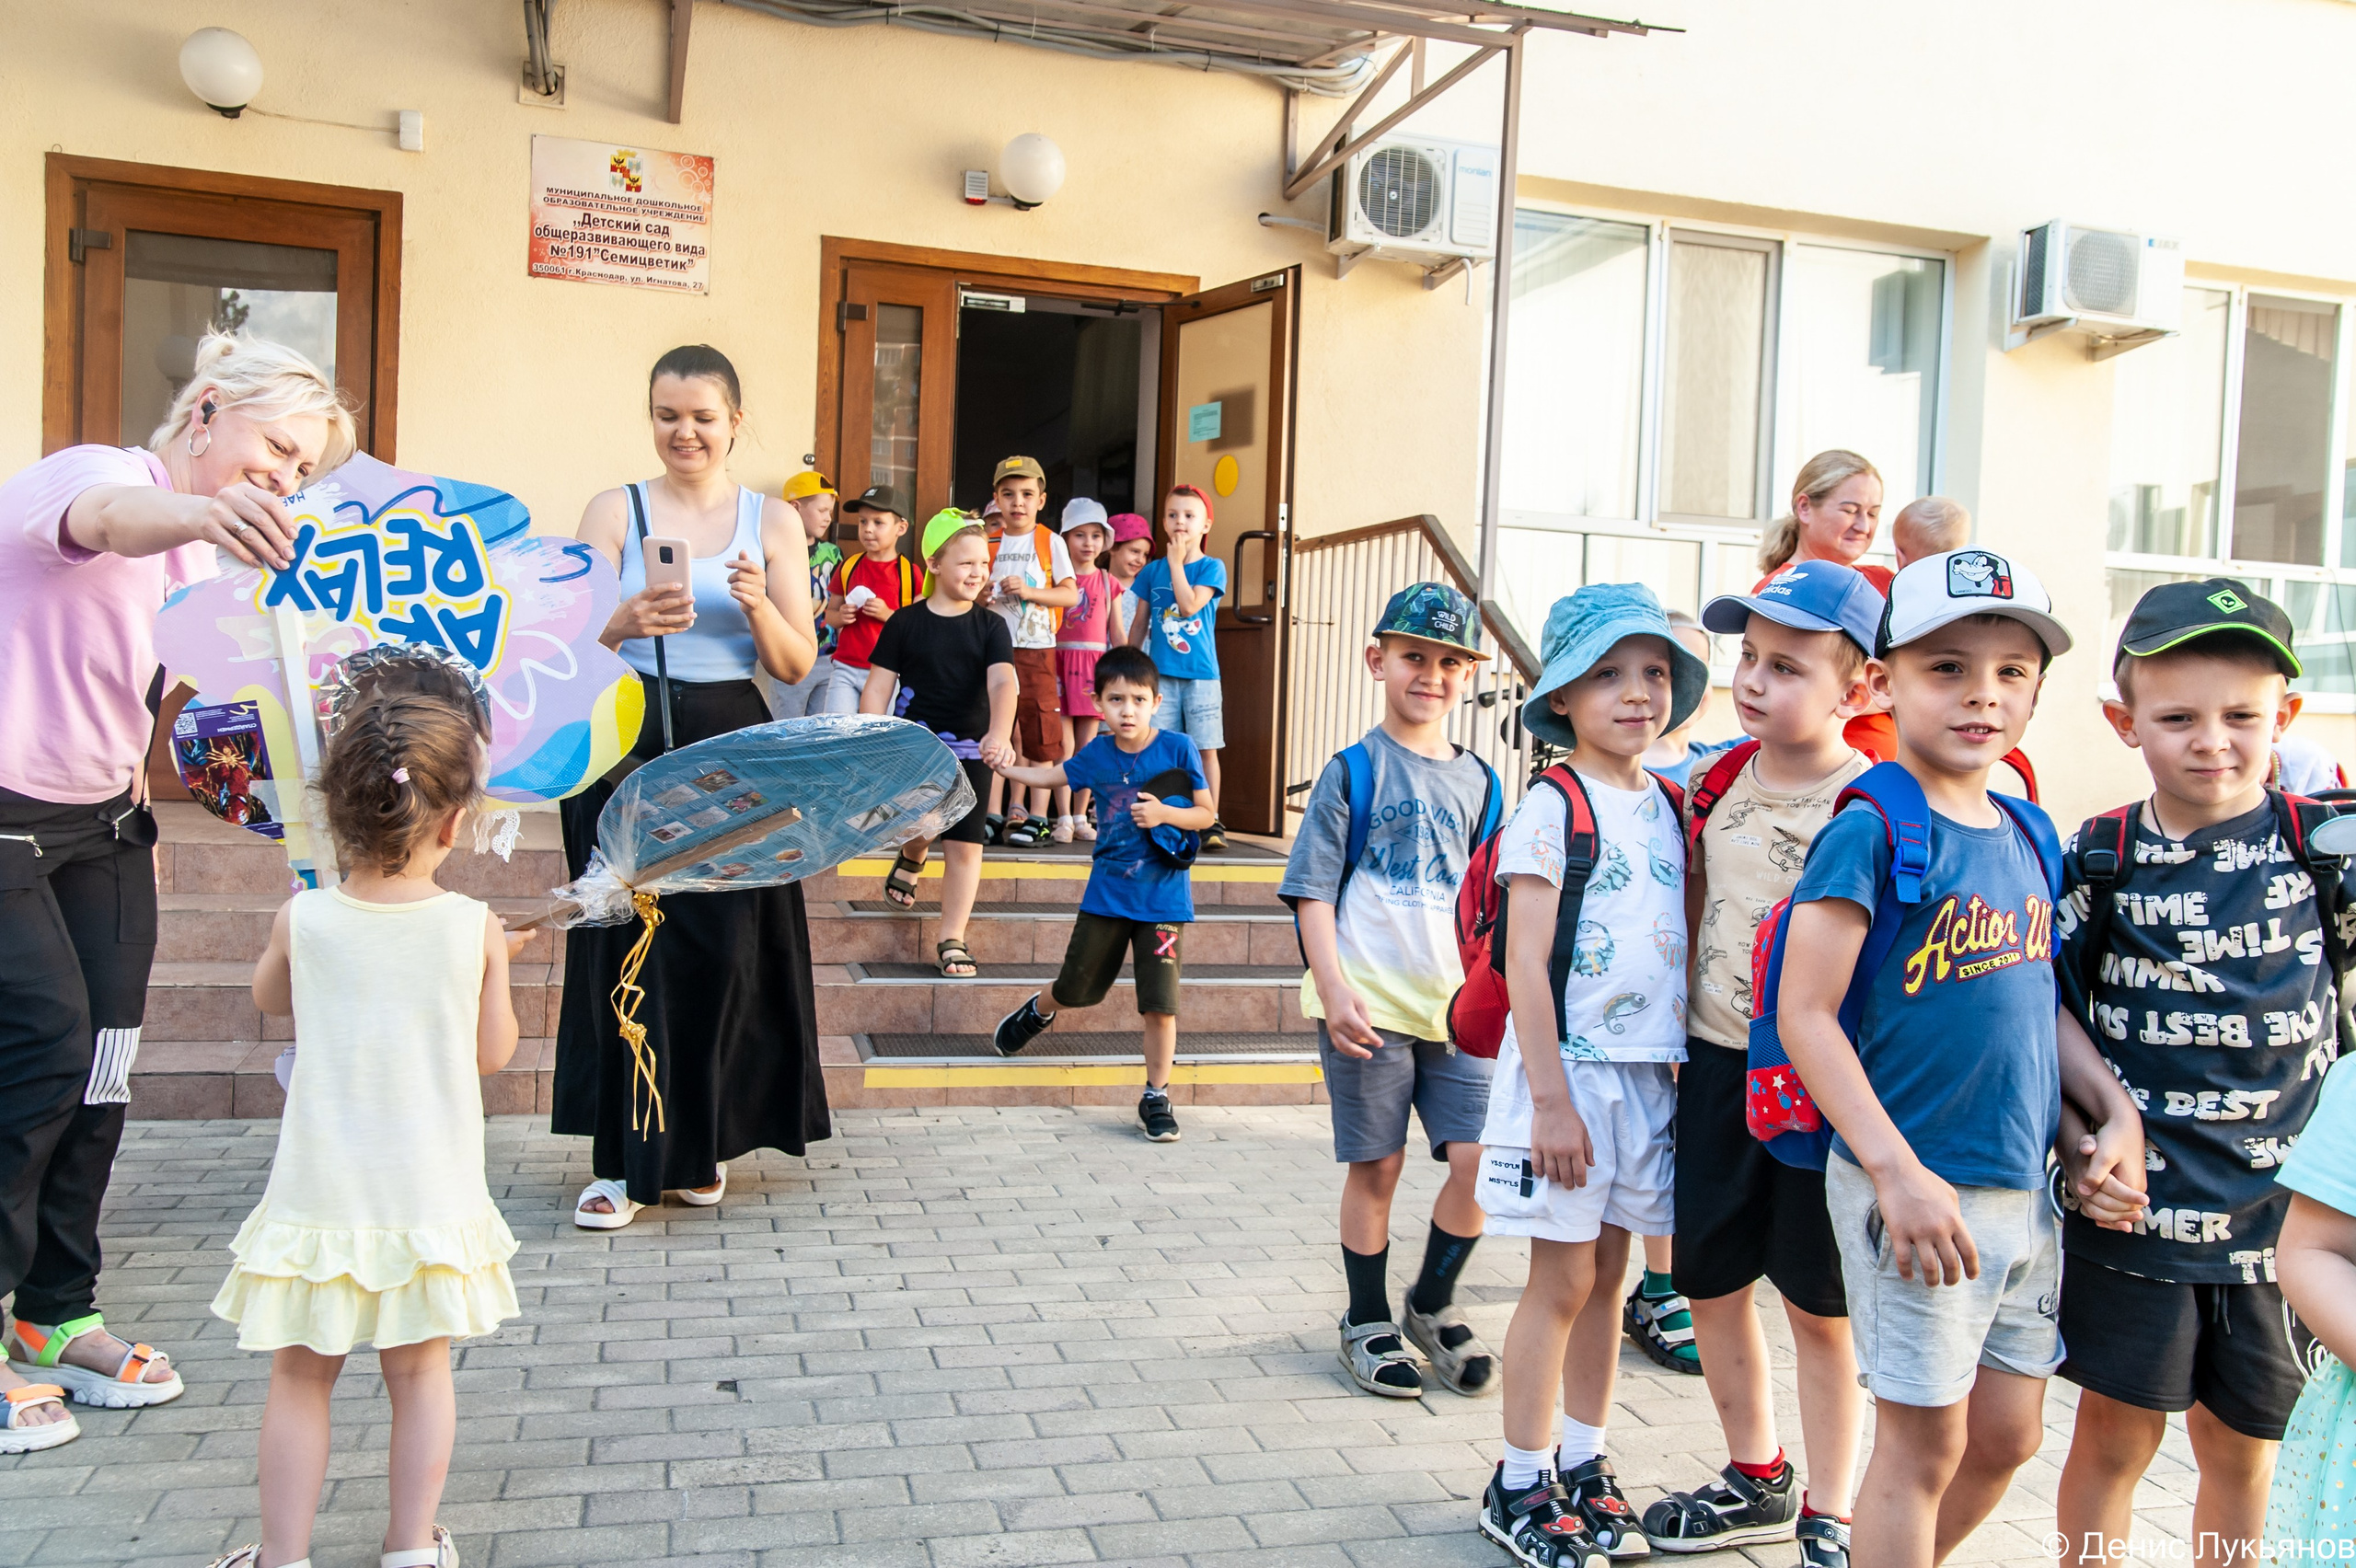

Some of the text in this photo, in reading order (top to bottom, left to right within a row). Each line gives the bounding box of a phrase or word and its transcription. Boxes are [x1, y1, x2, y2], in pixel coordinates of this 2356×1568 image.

[543, 196, 706, 223] ОБРАЗОВАТЕЛЬНОЕ УЧРЕЖДЕНИЕ
[546, 187, 703, 213] МУНИЦИПАЛЬНОЕ ДОШКОЛЬНОЕ
[535, 225, 706, 256] общеразвивающего вида
[645, 223, 670, 237] сад
[533, 264, 566, 274] 350061
[646, 276, 690, 289] Игнатова,
[693, 282, 703, 290] 27
[265, 518, 485, 622] RELAX
[1434, 621, 1455, 632] CHILD
[1437, 610, 1456, 622] WILD
[1369, 798, 1426, 830] GOOD
[1368, 841, 1424, 880] West
[1902, 894, 2021, 997] Action
[1962, 960, 1996, 976] SINCE
[2140, 1010, 2253, 1048] BEST
[2164, 1089, 2281, 1121] BEST
